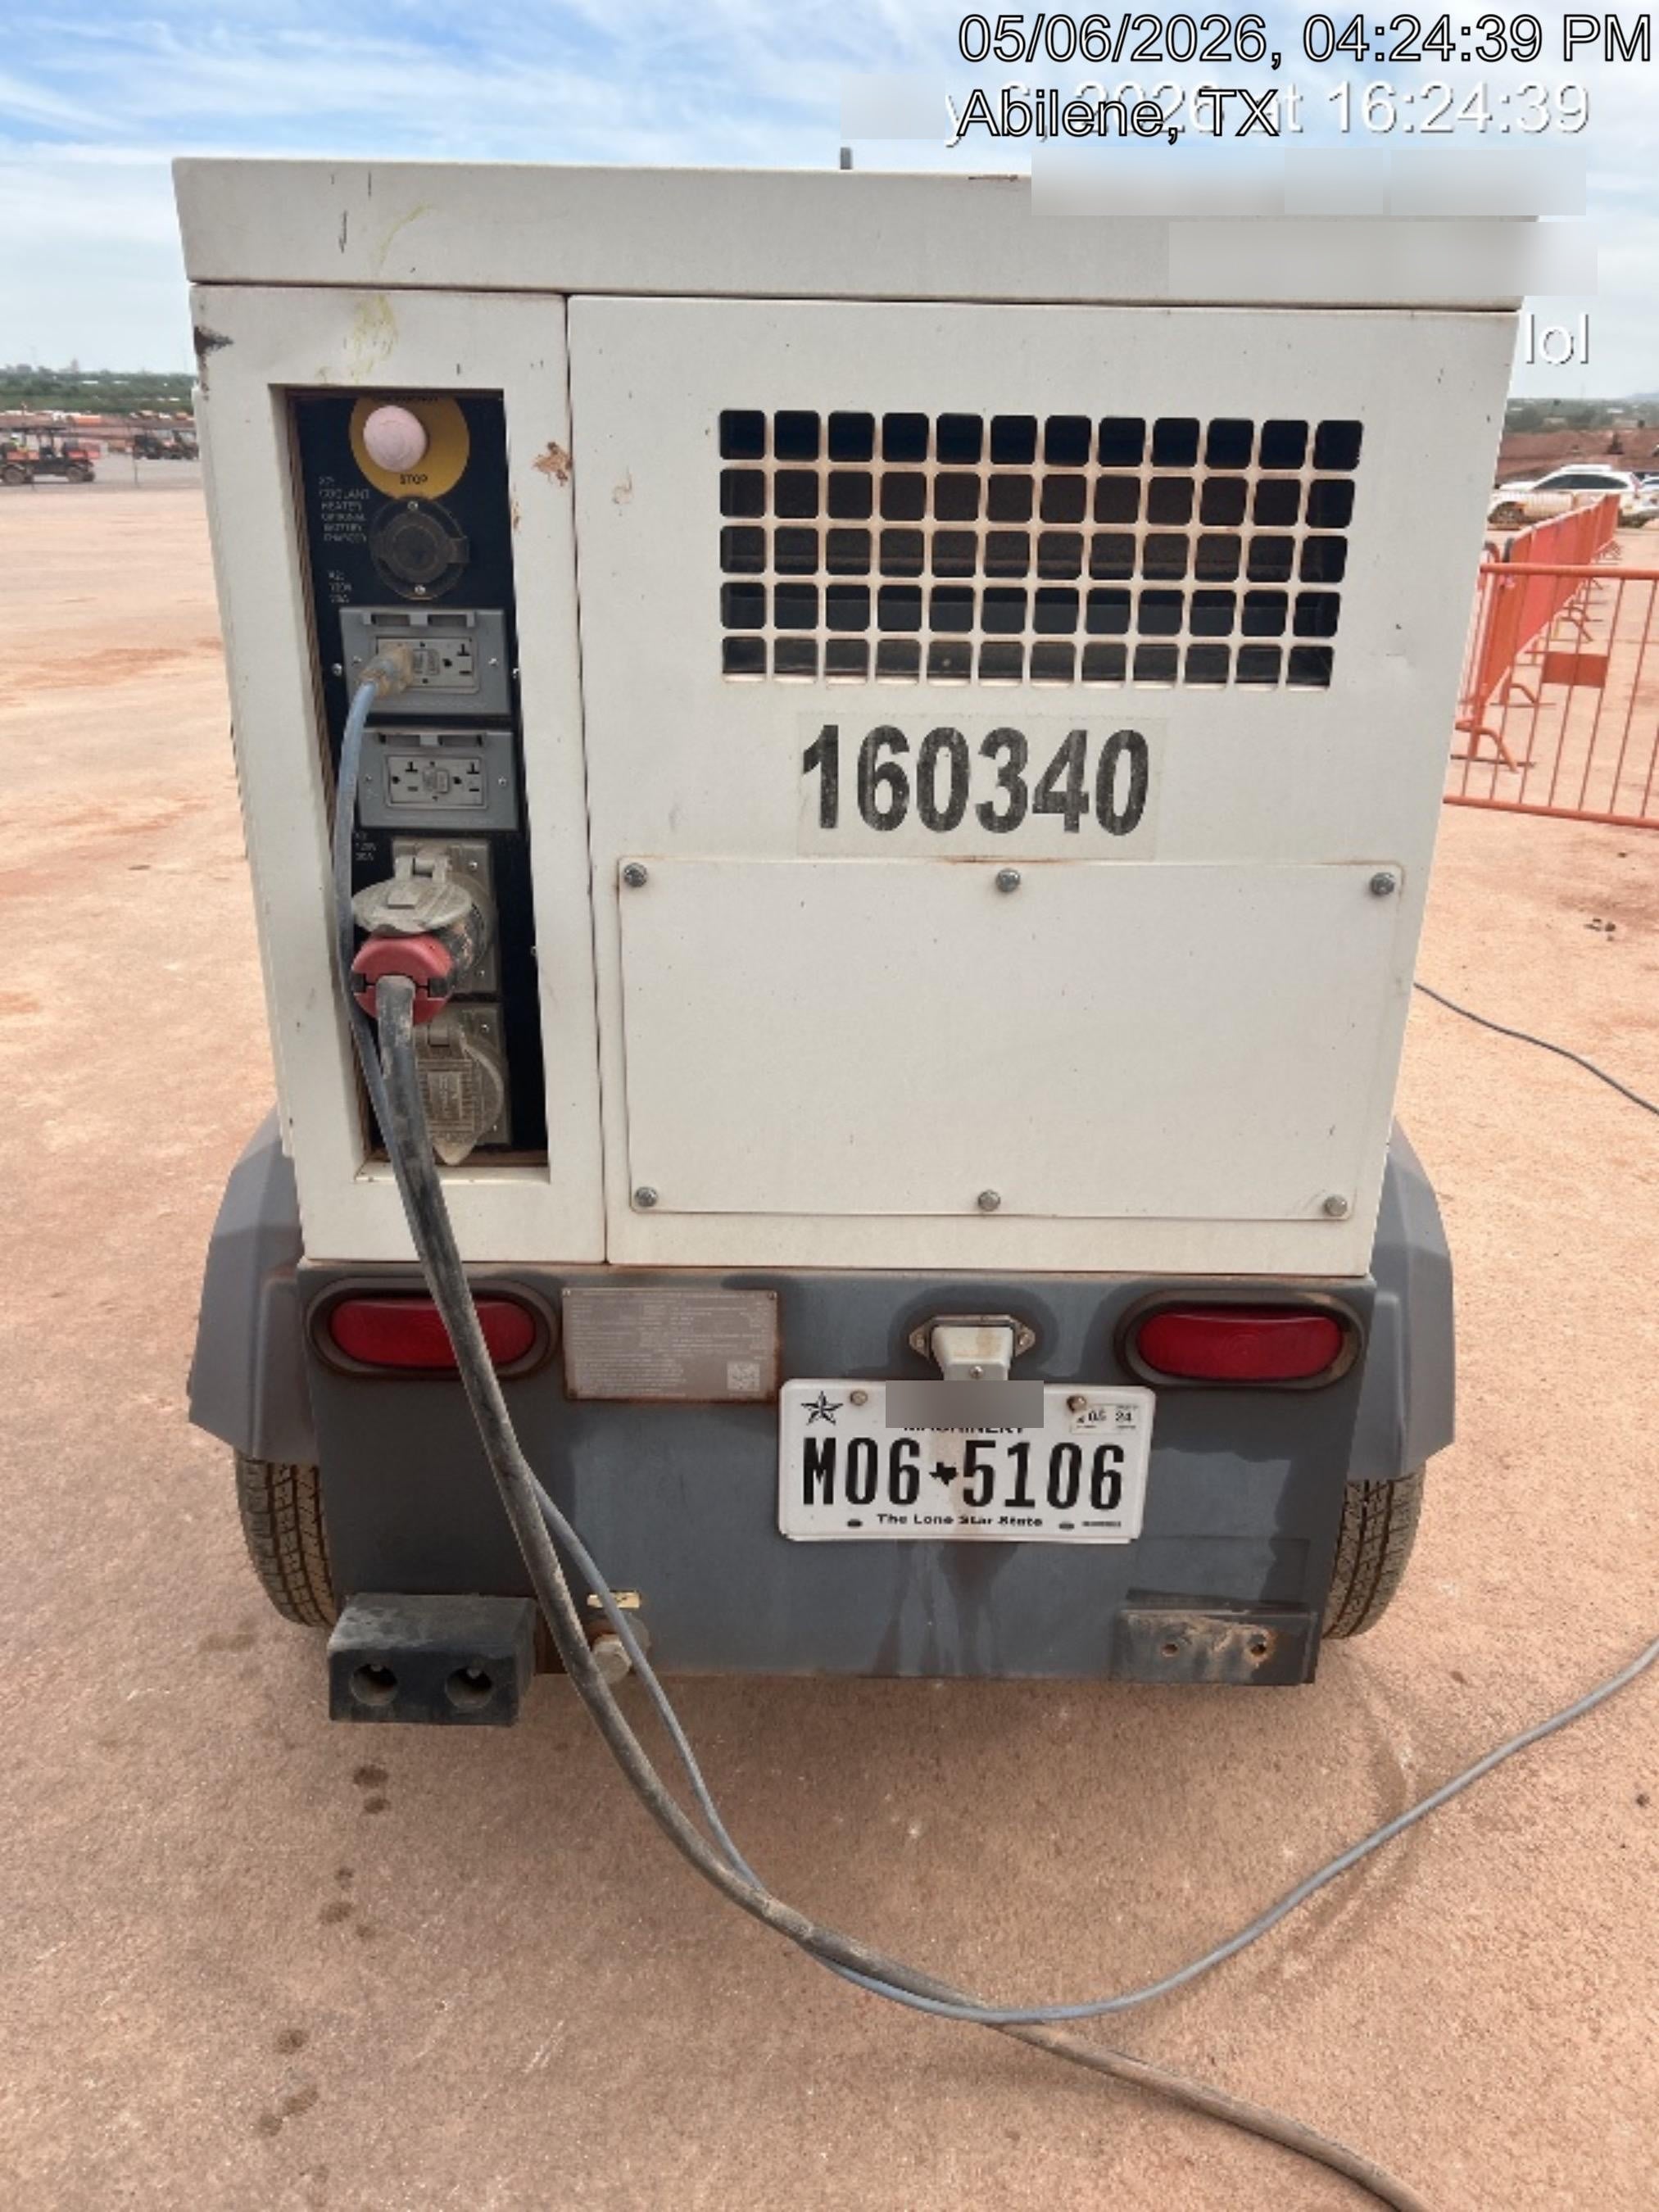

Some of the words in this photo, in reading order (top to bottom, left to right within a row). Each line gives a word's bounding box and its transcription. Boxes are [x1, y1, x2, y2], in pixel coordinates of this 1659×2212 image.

[399, 474, 428, 486] STOP
[802, 723, 1149, 836] 160340
[802, 1436, 921, 1507] M06
[962, 1439, 1126, 1511] 5106
[877, 1513, 908, 1525] The
[913, 1513, 954, 1525] Lone
[958, 1514, 994, 1525] Star
[997, 1515, 1044, 1527] State
